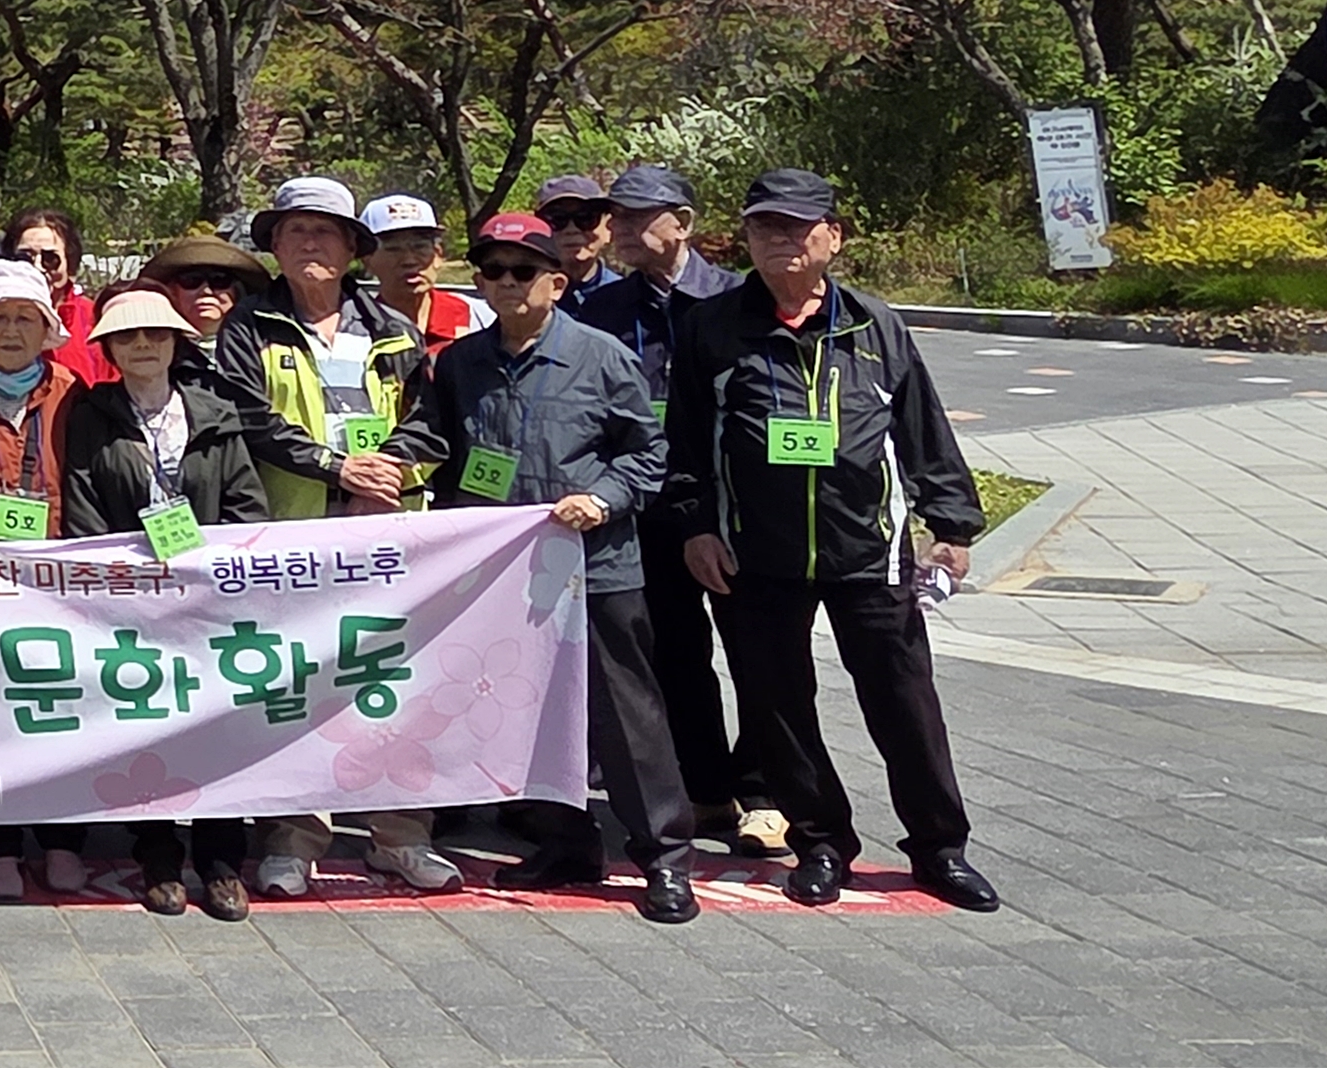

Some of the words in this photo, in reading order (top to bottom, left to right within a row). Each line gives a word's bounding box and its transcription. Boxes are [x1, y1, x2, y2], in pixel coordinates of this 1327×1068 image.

[782, 431, 822, 451] 5호
[471, 460, 501, 485] 5호
[4, 509, 37, 530] 5호
[34, 559, 186, 597] 미추홀구,
[211, 551, 321, 595] 행복한
[332, 546, 406, 585] 노후
